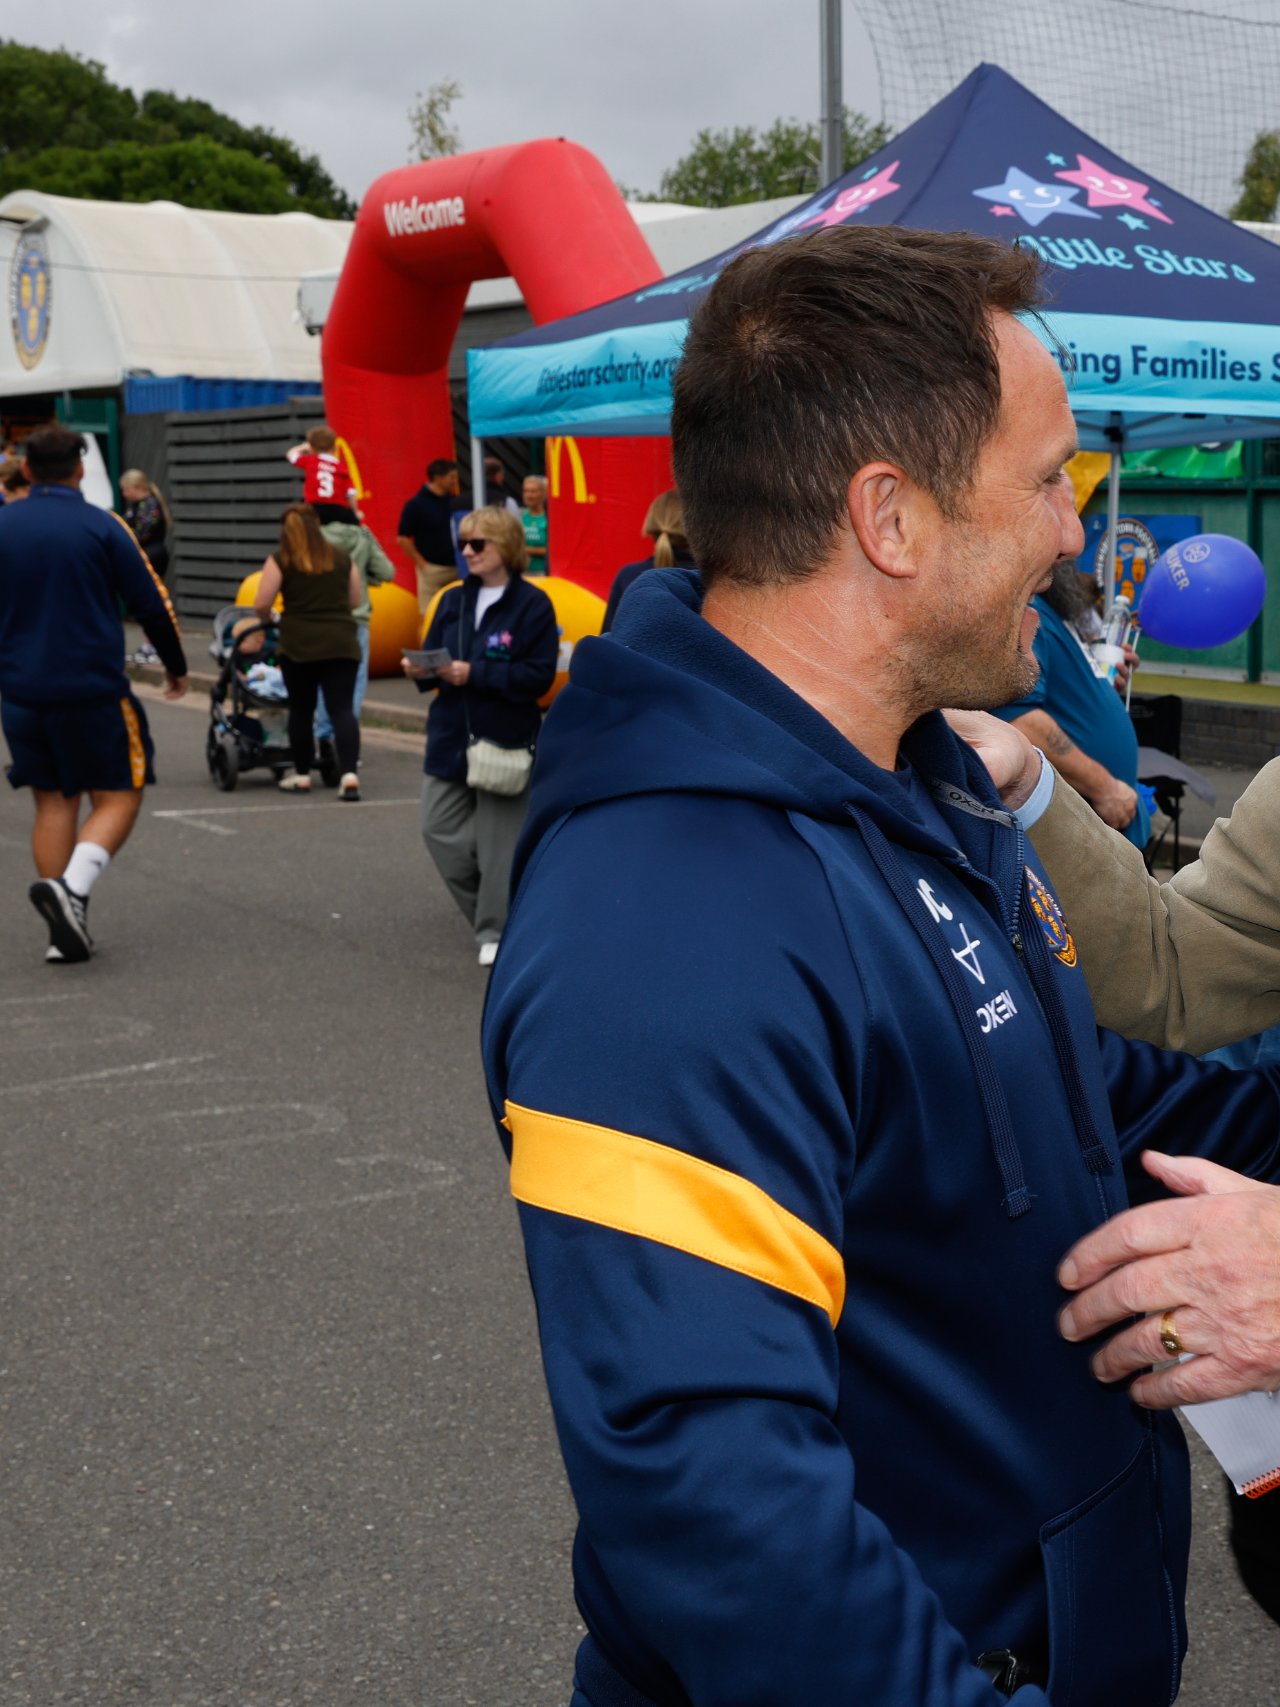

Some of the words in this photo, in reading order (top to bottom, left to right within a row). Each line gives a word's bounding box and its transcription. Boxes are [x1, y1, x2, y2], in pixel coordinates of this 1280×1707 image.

[384, 195, 465, 238] Welcome
[1012, 234, 1134, 270] Little
[1134, 244, 1256, 284] Stars
[1131, 345, 1262, 382] Families
[316, 470, 335, 498] 3
[949, 791, 995, 815] OXEN
